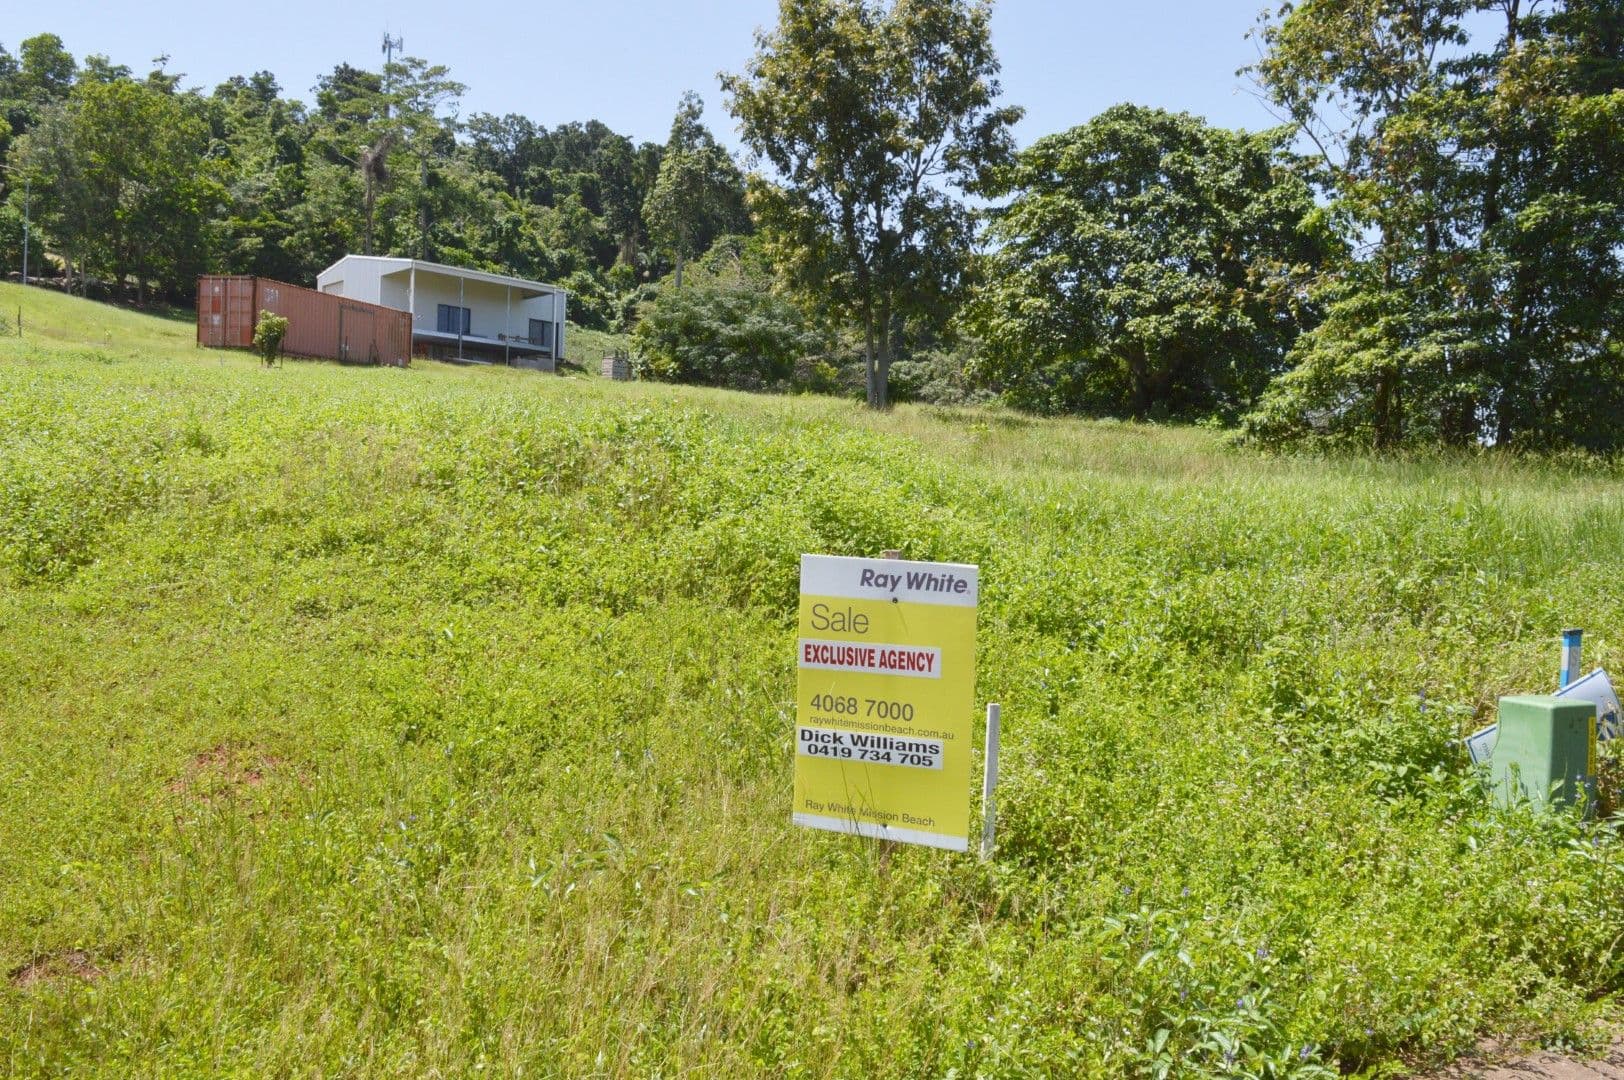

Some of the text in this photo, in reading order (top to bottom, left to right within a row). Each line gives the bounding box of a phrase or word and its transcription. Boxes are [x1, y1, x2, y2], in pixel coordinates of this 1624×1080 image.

[861, 568, 968, 594] Ray White
[811, 603, 869, 634] Sale
[804, 643, 935, 673] EXCLUSIVE AGENCY
[810, 694, 914, 722] 4068 7000
[809, 716, 955, 740] raywhitemissionbeach.com.au
[800, 729, 940, 755] Dick Williams
[807, 743, 934, 767] 0419 734 705
[805, 800, 936, 828] Ray White Mission Beach
